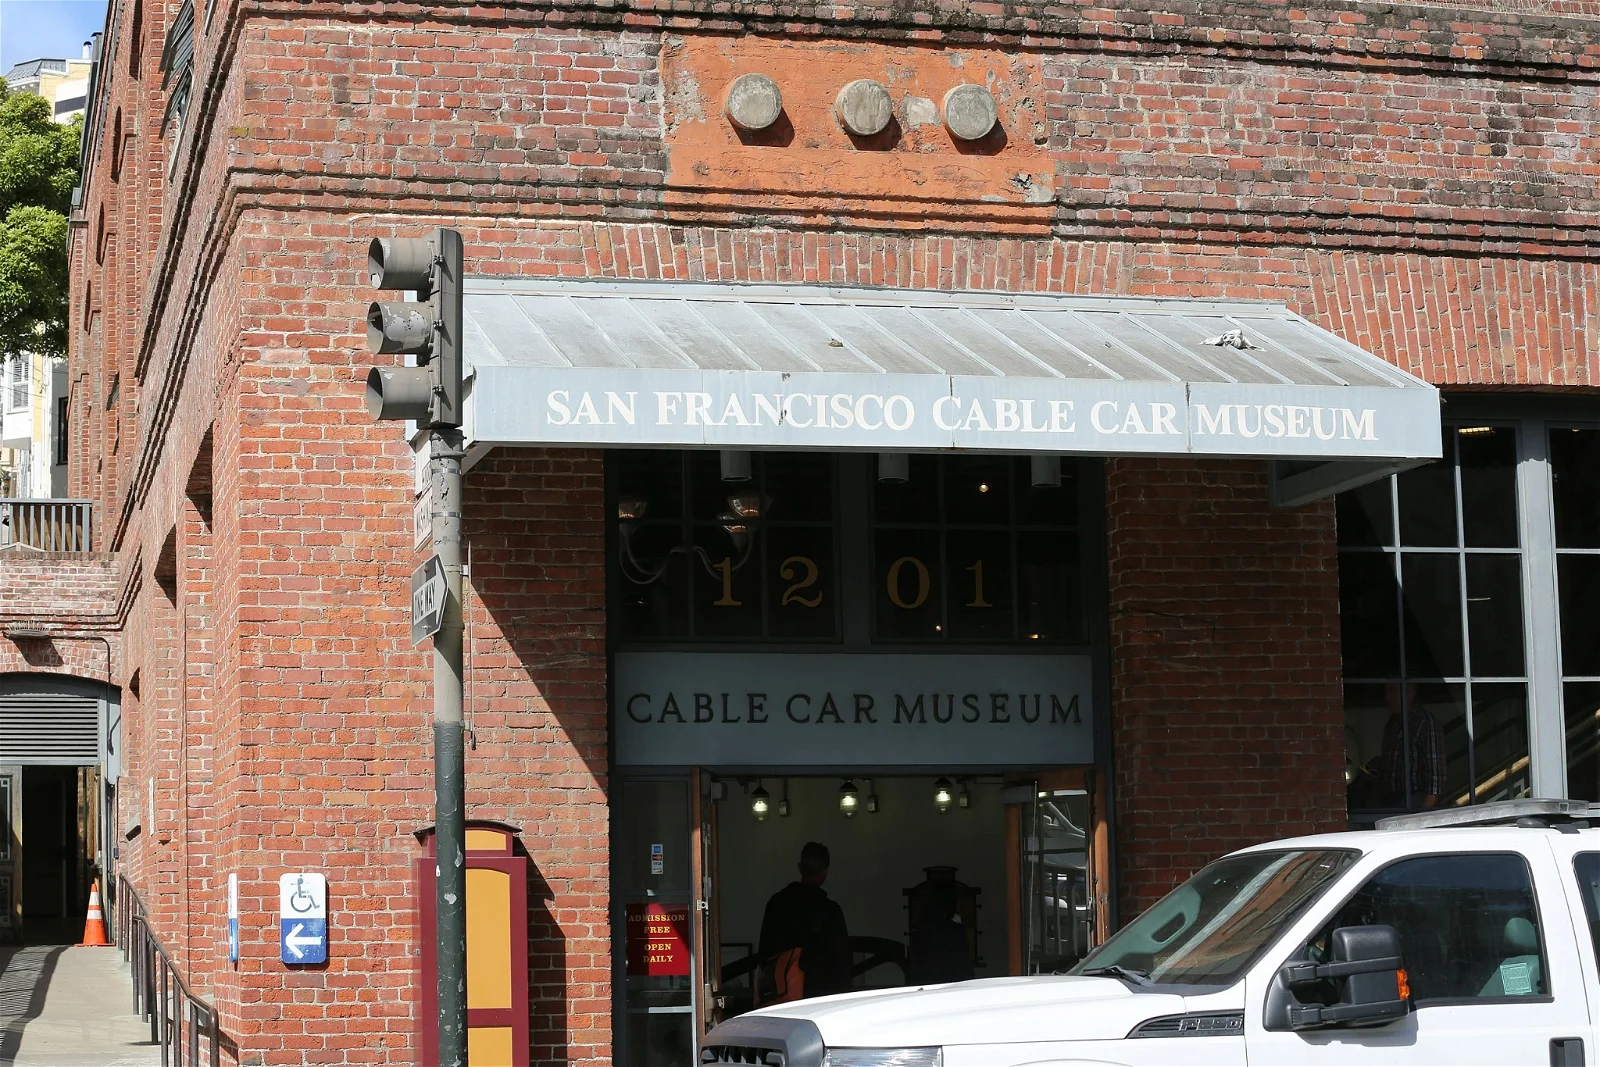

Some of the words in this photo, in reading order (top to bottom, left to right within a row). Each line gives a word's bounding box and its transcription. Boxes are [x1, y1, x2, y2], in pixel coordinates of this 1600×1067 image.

[546, 389, 639, 426] SAN
[653, 390, 916, 431] FRANCISCO
[932, 395, 1076, 434] CABLE
[1090, 400, 1182, 436] CAR
[1194, 403, 1380, 442] MUSEUM
[415, 589, 424, 621] ONE
[424, 579, 436, 613] WAY
[626, 691, 769, 724] CABLE
[785, 692, 878, 725] CAR
[893, 693, 1083, 725] MUSEUM
[628, 914, 685, 922] ADMISSION
[643, 926, 671, 934] FREE
[644, 943, 672, 951] OPEN
[643, 955, 673, 963] DAILY
